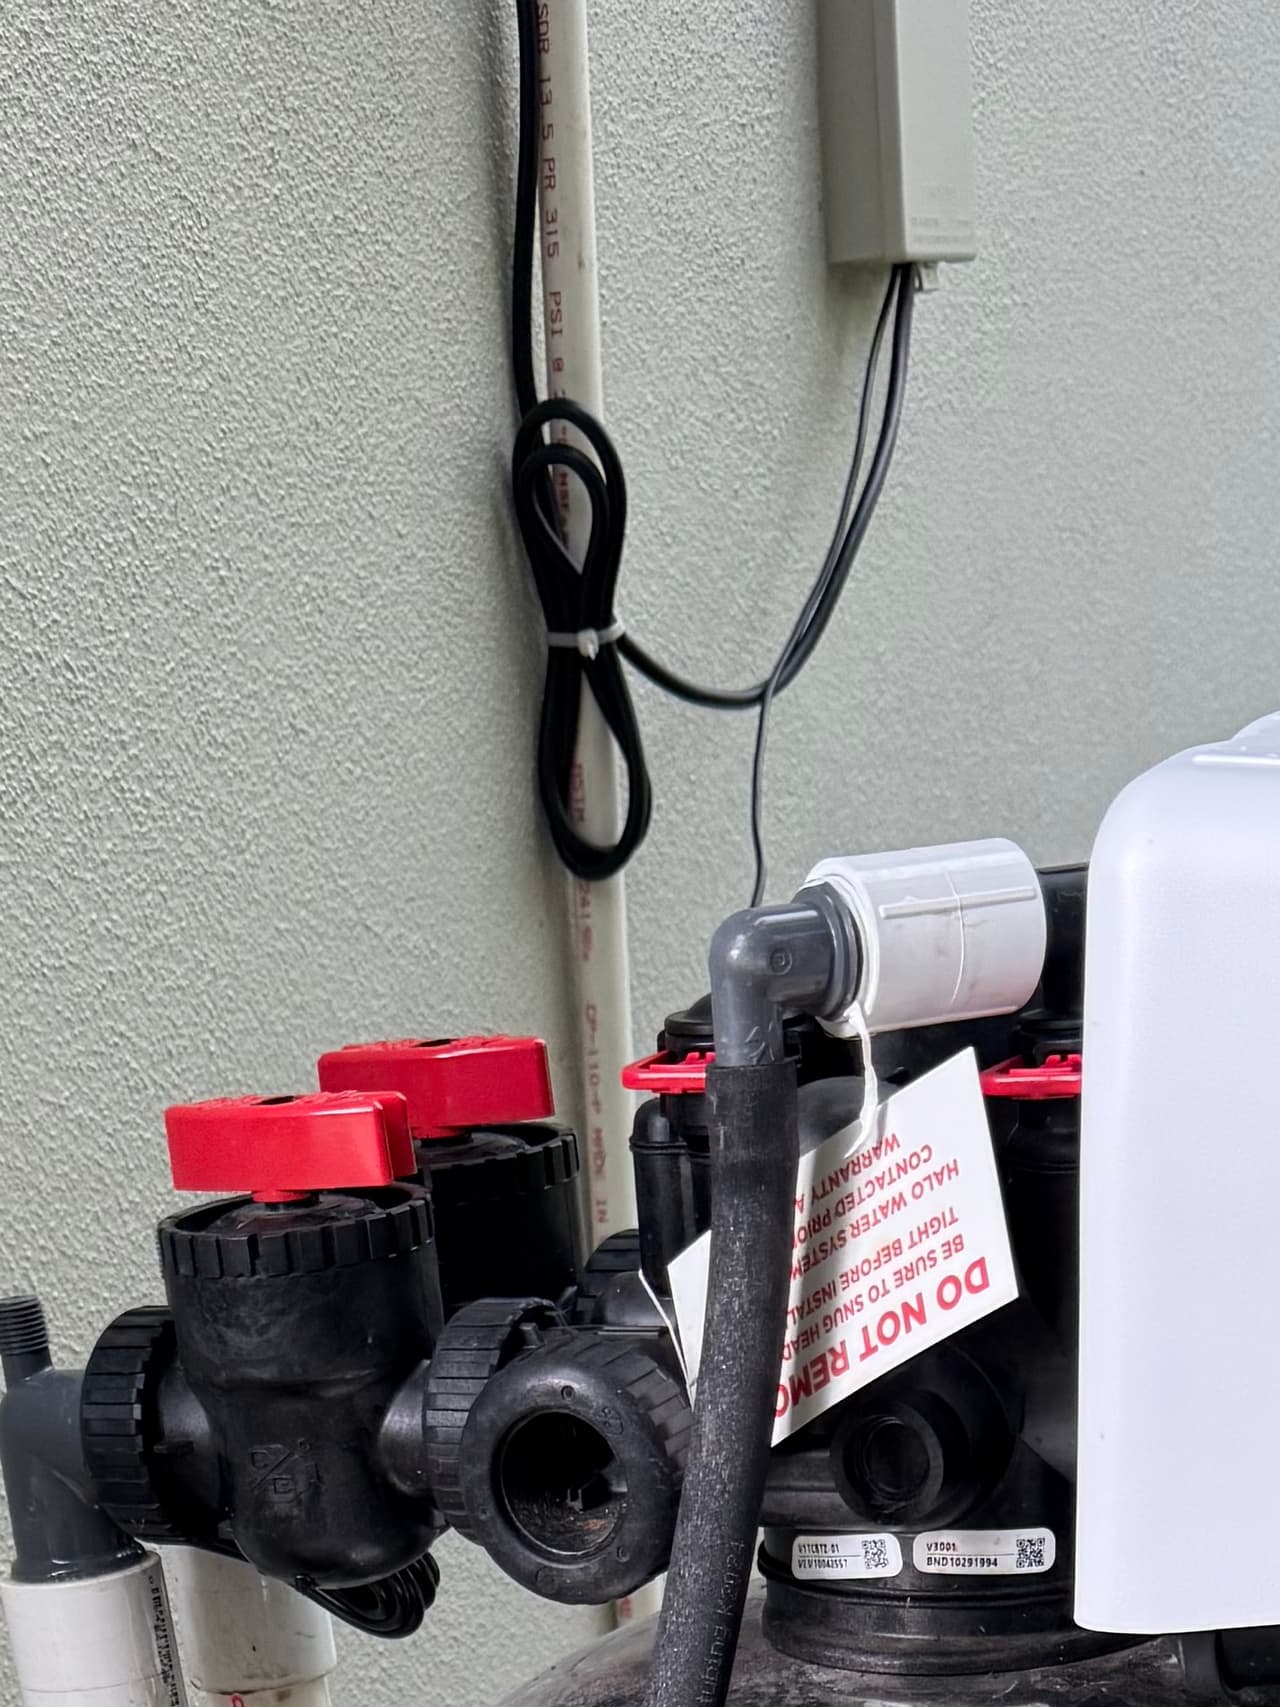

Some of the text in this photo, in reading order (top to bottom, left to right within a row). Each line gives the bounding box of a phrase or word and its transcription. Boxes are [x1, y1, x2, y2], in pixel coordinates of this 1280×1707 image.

[544, 157, 556, 190] PR
[546, 208, 560, 258] 315
[549, 291, 563, 338] PSI
[811, 1133, 901, 1206] WARRANTY
[911, 1158, 960, 1200] HALO
[791, 1144, 933, 1249] CONTACTED PRIO
[850, 1191, 908, 1239] WATER
[908, 1207, 959, 1250] TIGHT
[941, 1234, 965, 1260] BE
[841, 1238, 903, 1291] BEFORE
[893, 1250, 938, 1289] SURE
[868, 1278, 891, 1303] TO
[823, 1294, 864, 1334] SNUG
[775, 1256, 990, 1418] DO NOT REMO
[926, 1542, 957, 1552] V3001
[926, 1557, 998, 1567] BND10291994
